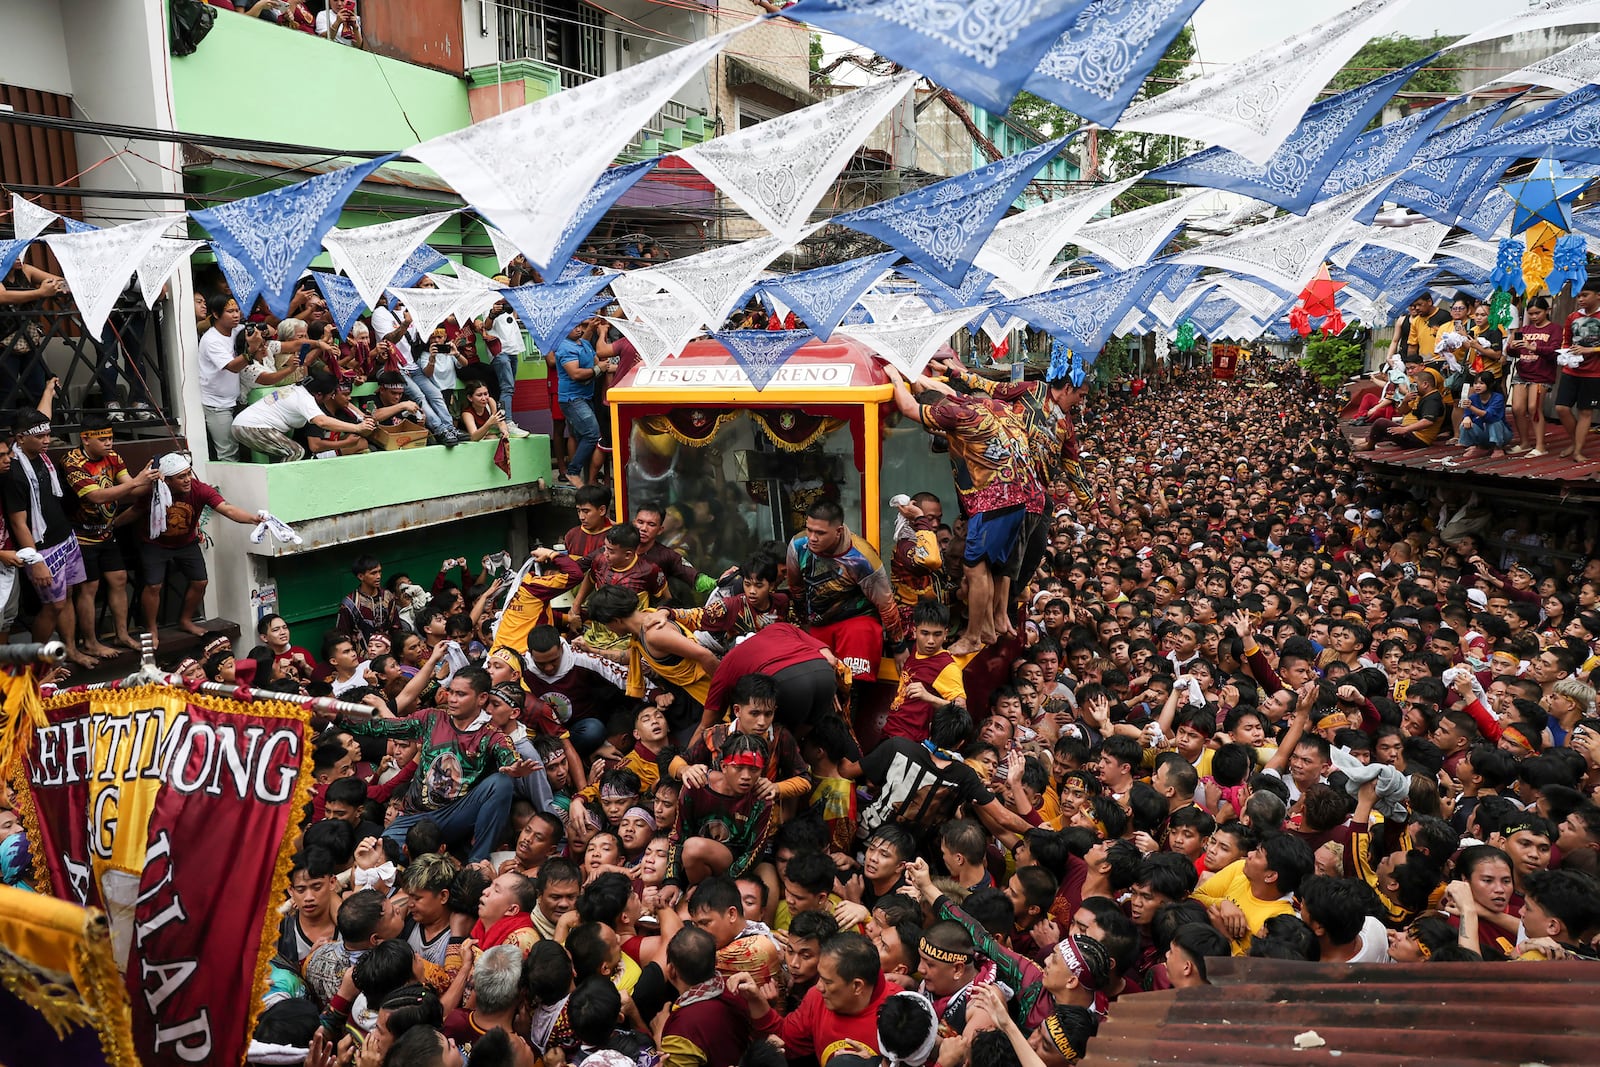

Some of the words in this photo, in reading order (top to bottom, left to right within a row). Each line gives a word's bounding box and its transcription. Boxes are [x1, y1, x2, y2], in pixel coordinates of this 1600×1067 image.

[648, 369, 706, 383] JESUS
[712, 367, 838, 382] NARENO
[925, 943, 967, 962] NAZARENO
[1058, 938, 1081, 969] ZARENO
